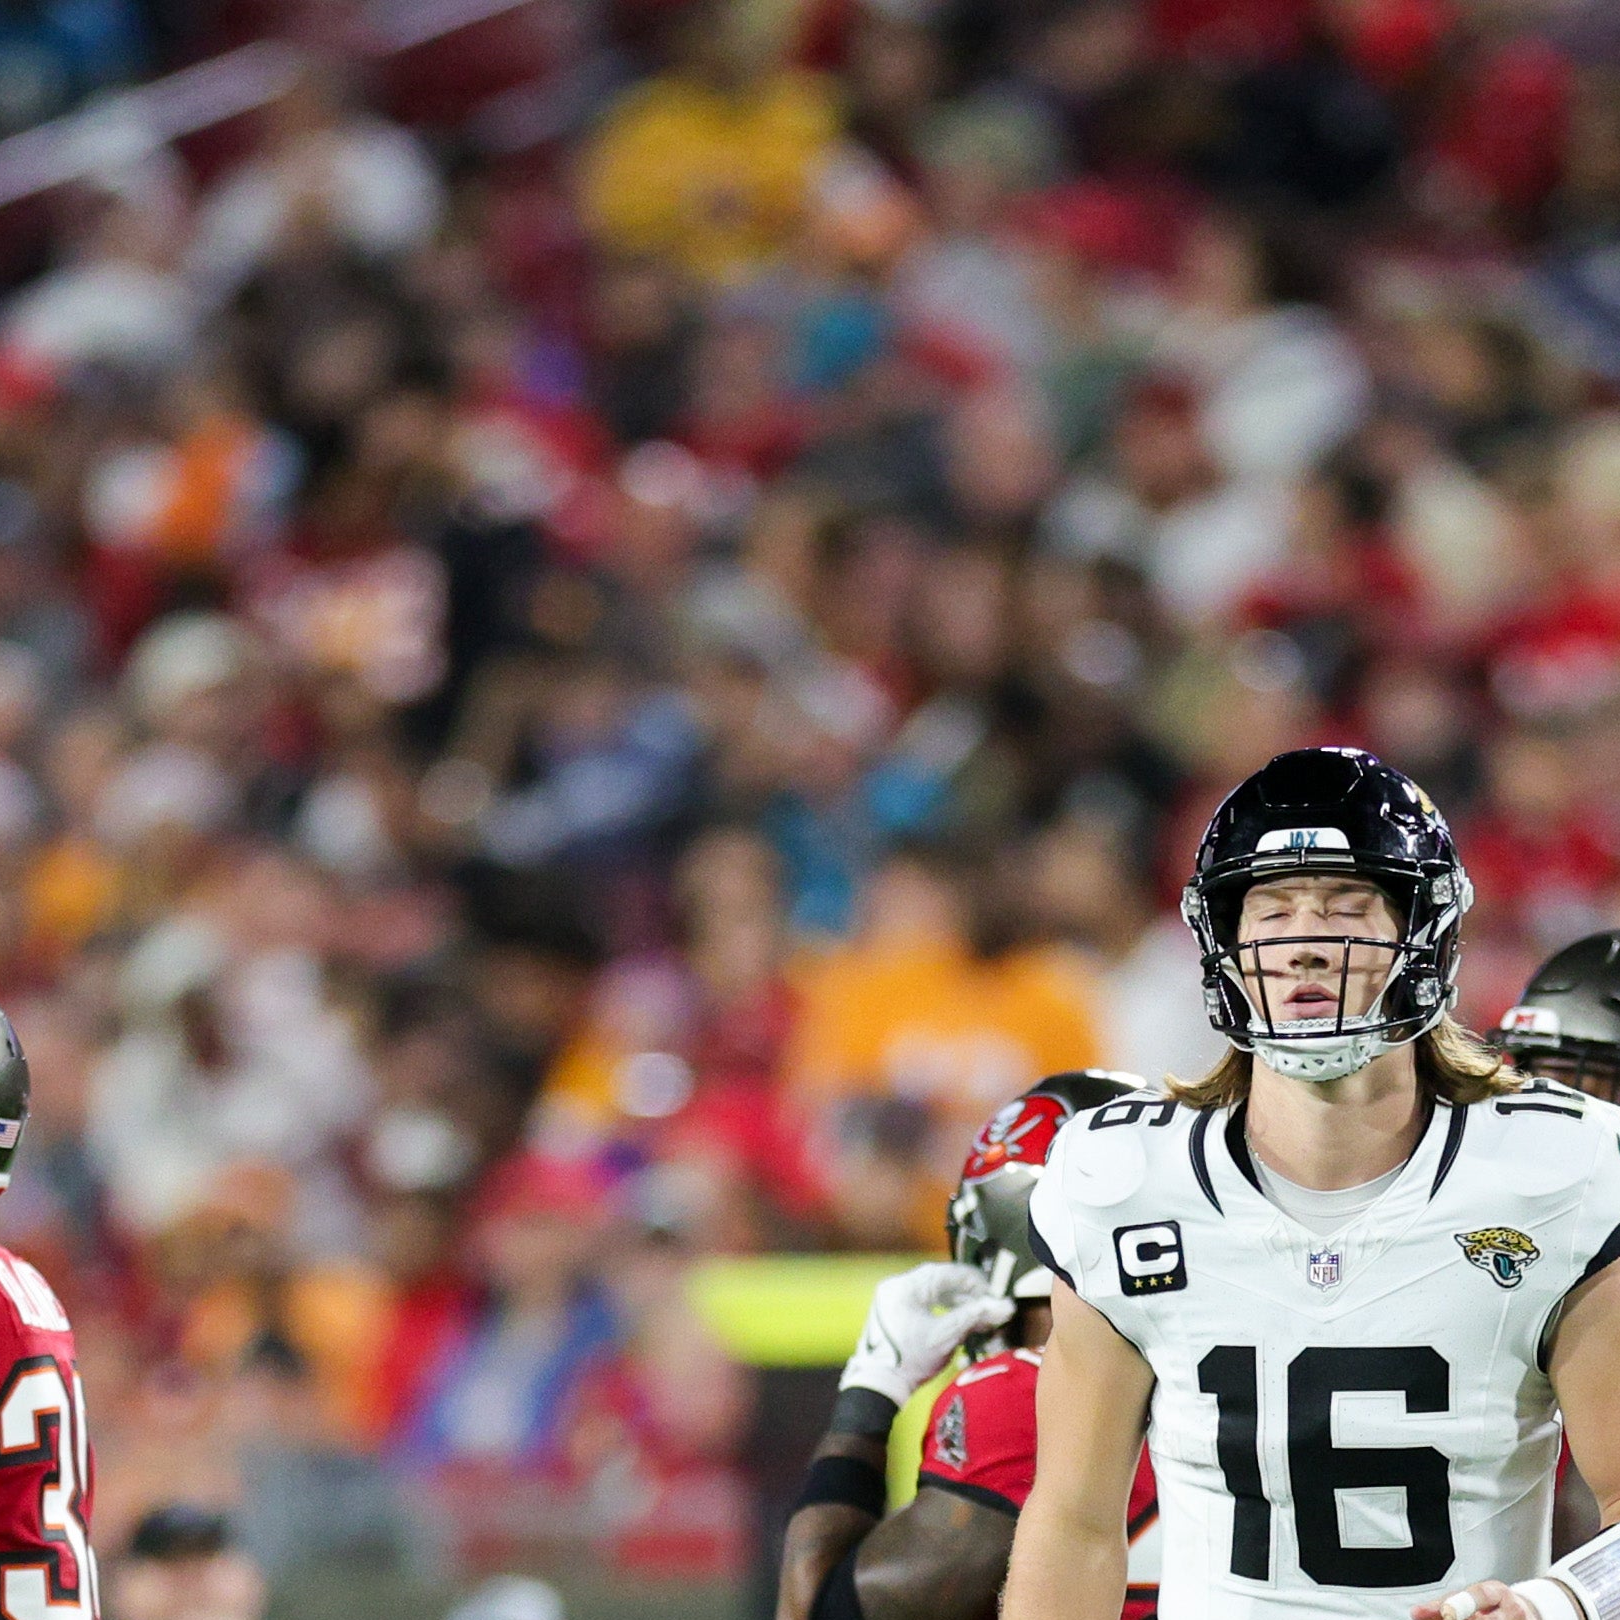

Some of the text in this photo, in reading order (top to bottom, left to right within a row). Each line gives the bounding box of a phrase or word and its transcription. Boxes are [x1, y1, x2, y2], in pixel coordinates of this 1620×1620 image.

[1283, 830, 1319, 849] JAX
[1119, 1226, 1180, 1278] C
[1196, 1344, 1457, 1589] 16
